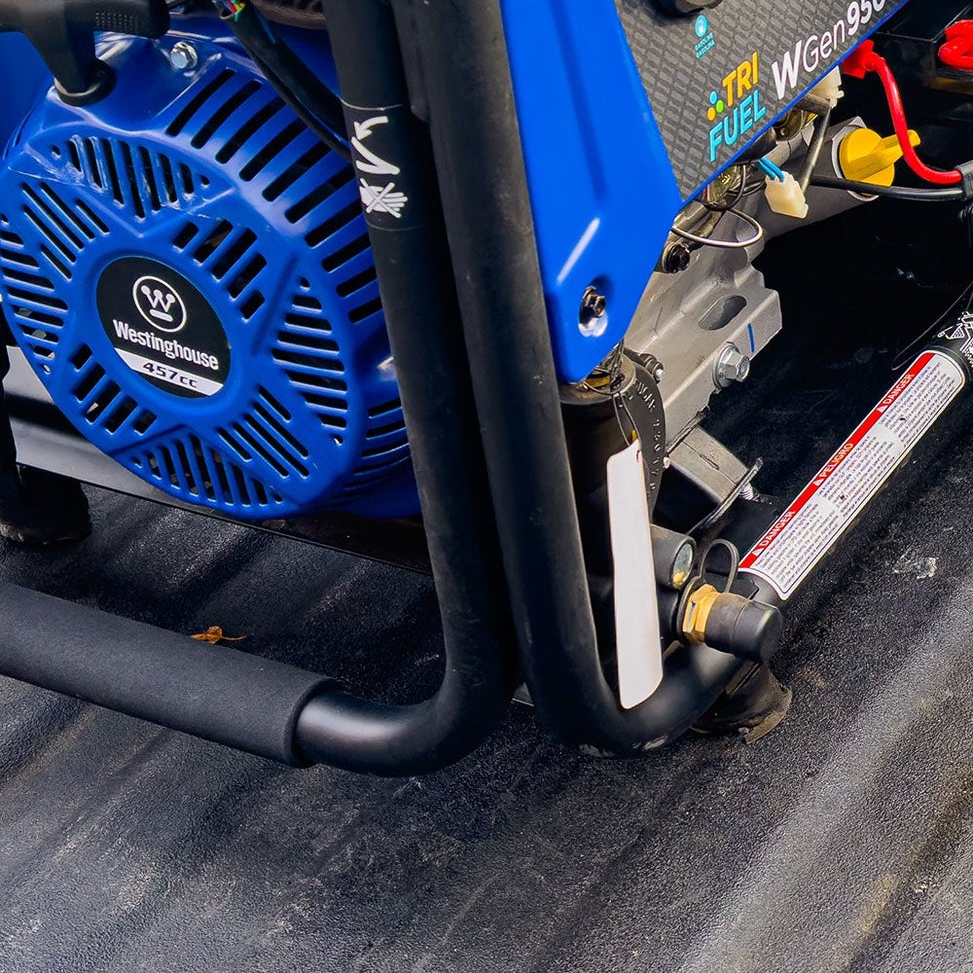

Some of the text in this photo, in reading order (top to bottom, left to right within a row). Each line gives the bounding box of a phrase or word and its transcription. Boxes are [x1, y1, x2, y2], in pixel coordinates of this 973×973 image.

[722, 51, 759, 108] TRI
[709, 89, 767, 162] FUEL
[112, 318, 219, 371] Westinghouse
[143, 362, 198, 389] 457cc
[885, 373, 915, 406] DANGER
[820, 442, 854, 479] PELIGRO
[761, 509, 796, 547] DANGER
